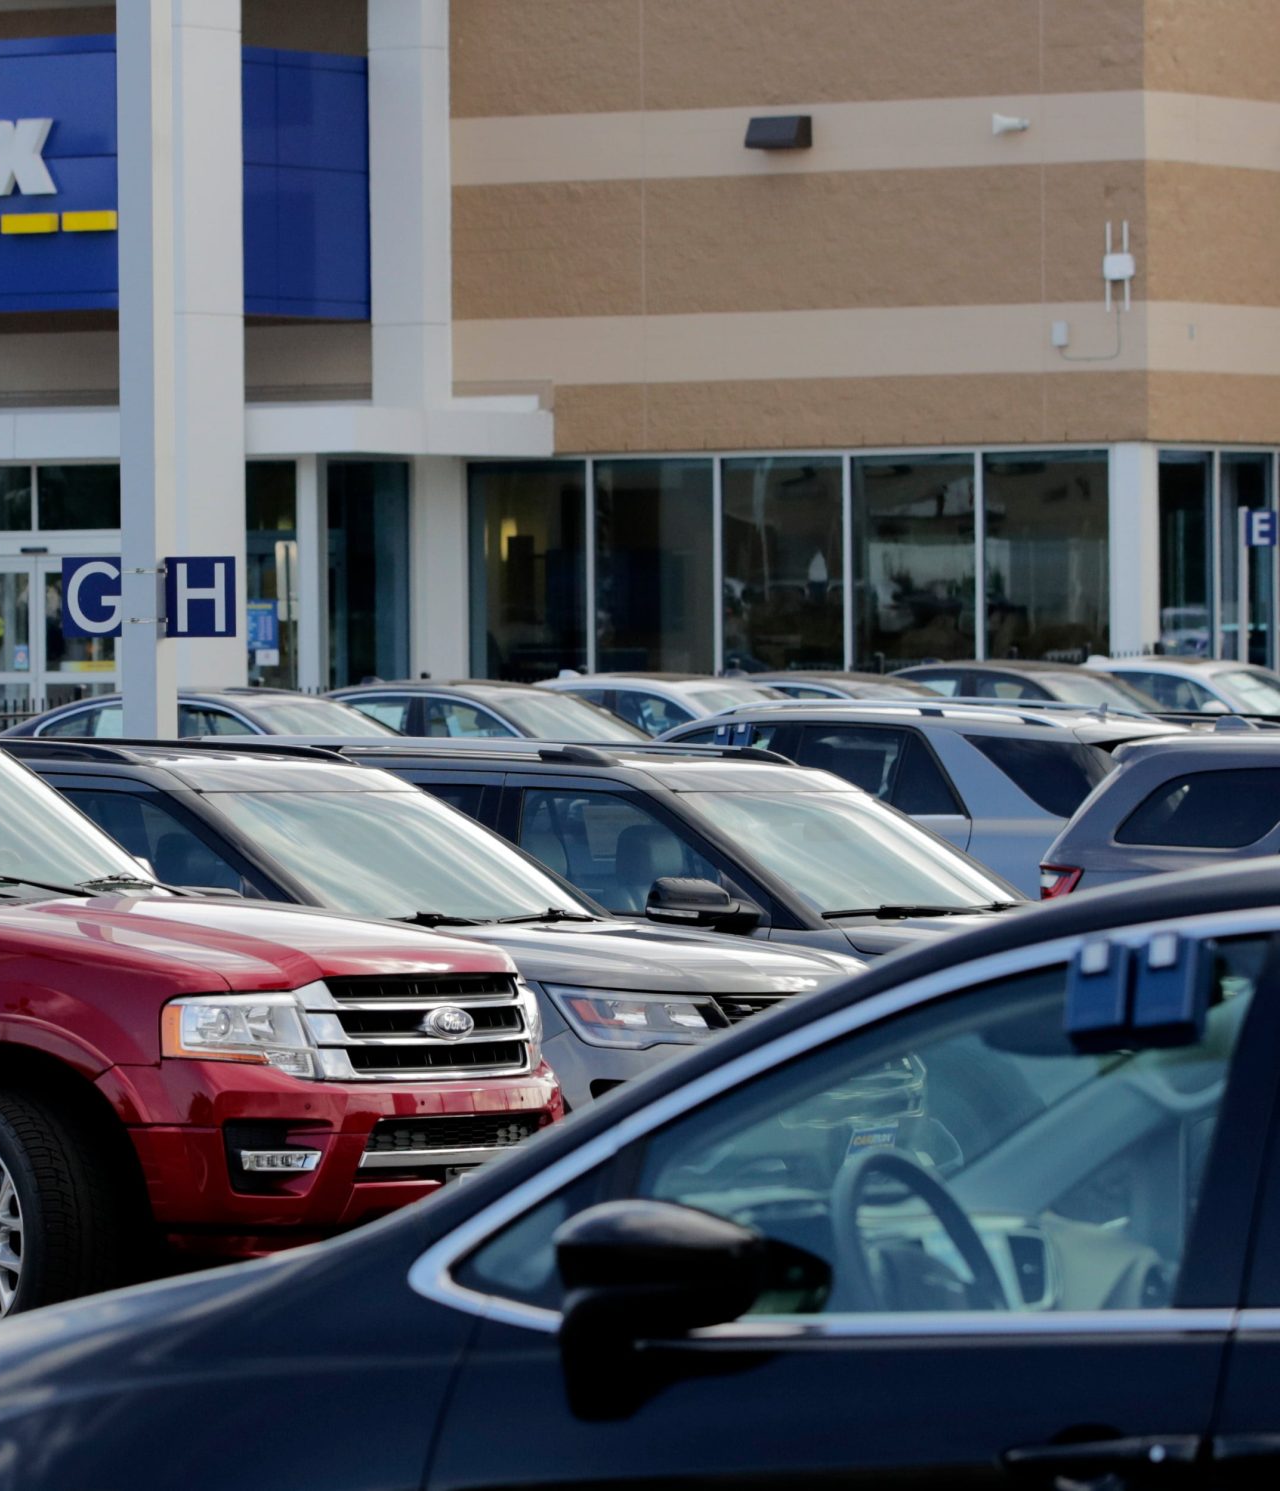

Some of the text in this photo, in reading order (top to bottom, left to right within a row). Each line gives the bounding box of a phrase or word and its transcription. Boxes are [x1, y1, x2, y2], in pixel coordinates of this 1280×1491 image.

[1251, 511, 1271, 546] E
[66, 560, 122, 634] G
[175, 562, 227, 633] H
[443, 1012, 468, 1031] Ford
